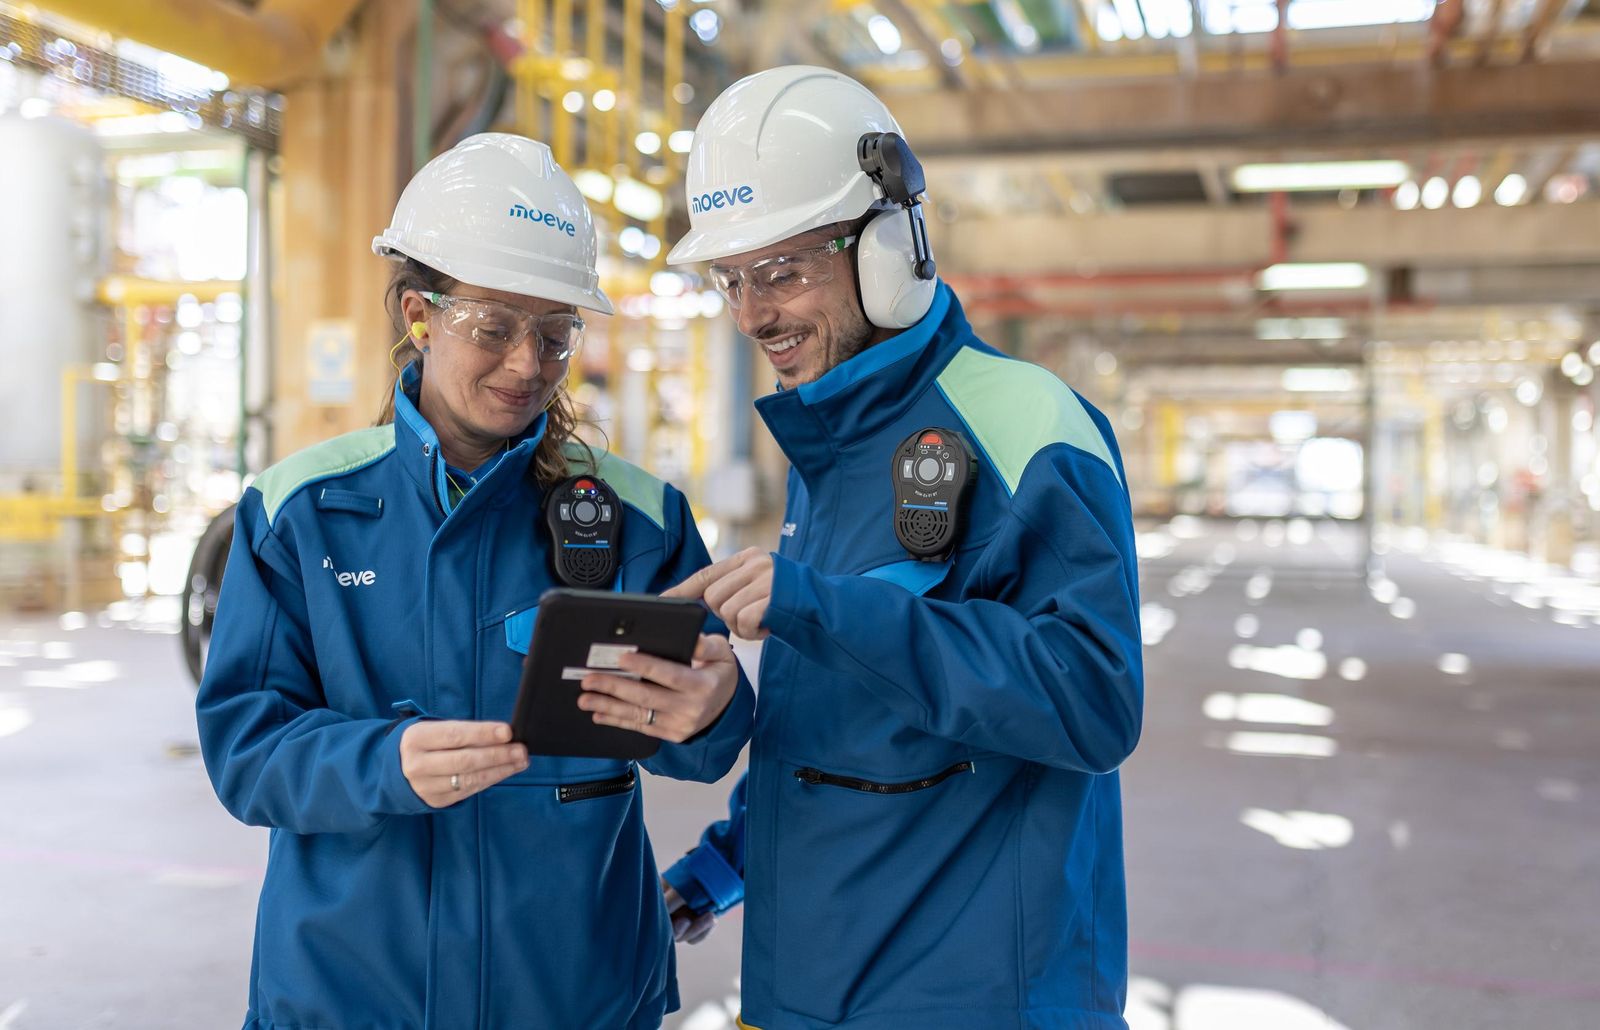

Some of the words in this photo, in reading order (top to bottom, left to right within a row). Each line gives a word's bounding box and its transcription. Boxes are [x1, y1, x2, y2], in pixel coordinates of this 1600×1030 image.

[692, 185, 754, 214] moeve
[509, 204, 576, 237] moeve
[323, 555, 376, 587] meve
